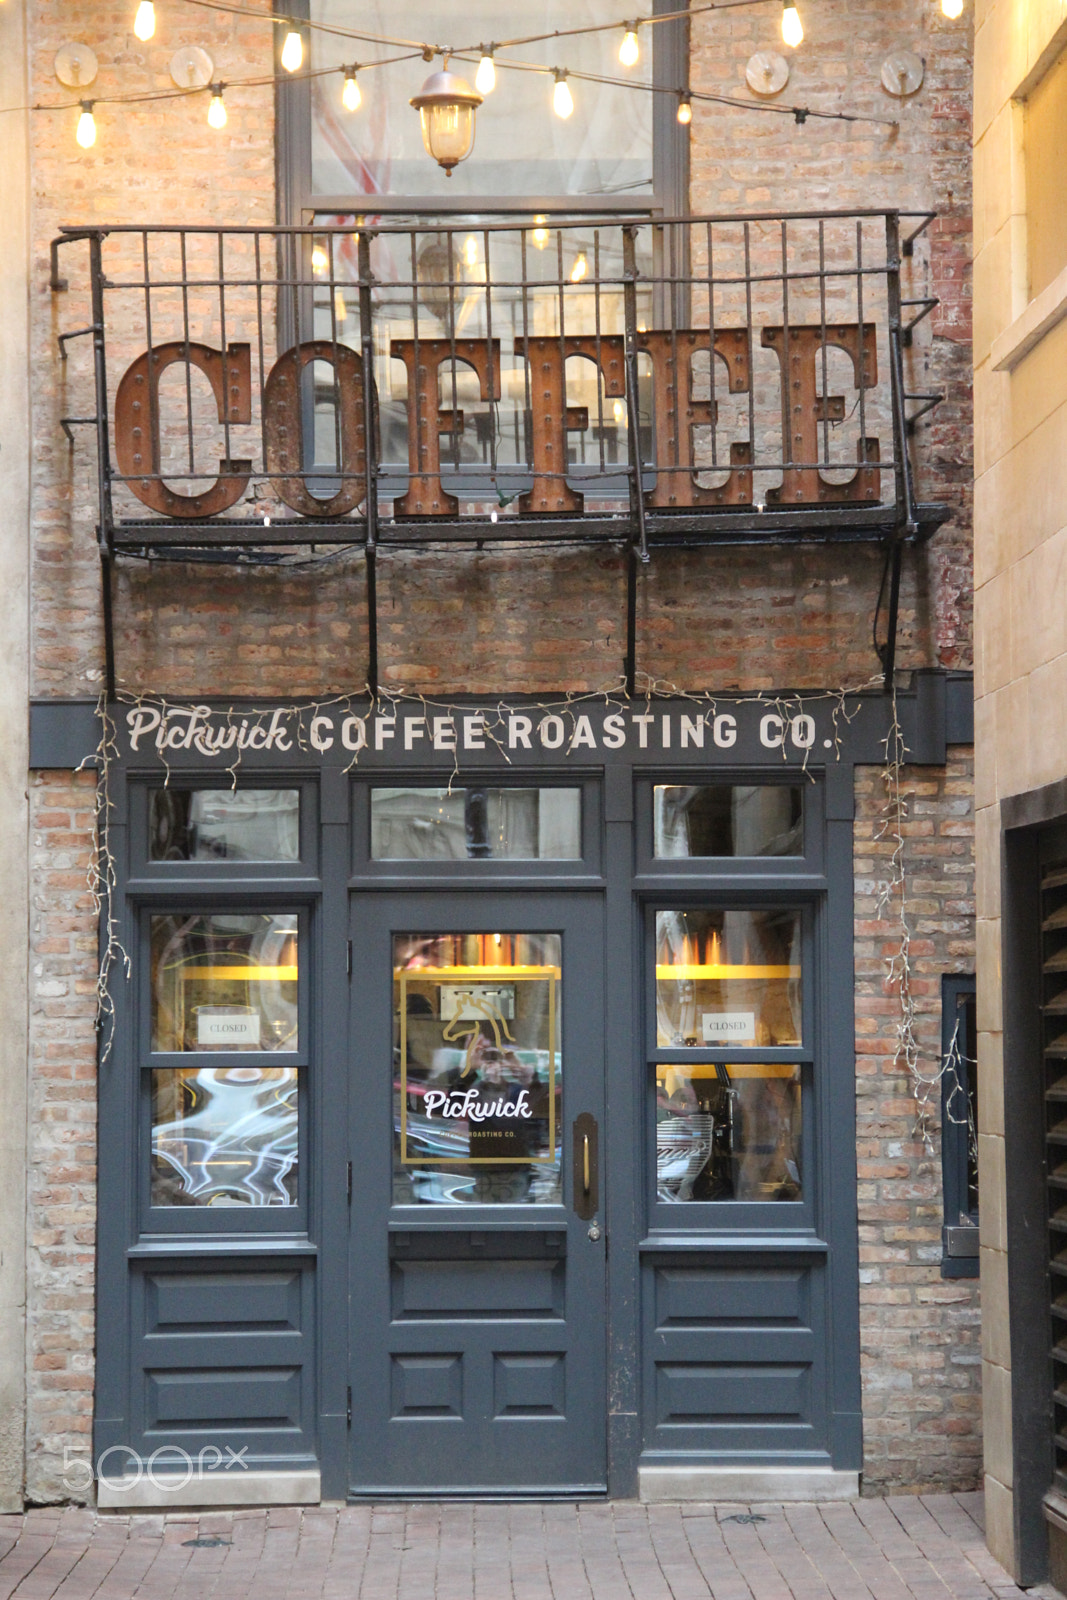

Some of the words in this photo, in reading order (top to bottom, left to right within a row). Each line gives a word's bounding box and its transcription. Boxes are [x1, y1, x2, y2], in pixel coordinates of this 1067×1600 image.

[115, 323, 880, 517] COFFEE
[126, 705, 292, 756] Pickwick
[309, 716, 486, 751] COFFEE
[508, 713, 738, 749] ROASTING
[759, 714, 833, 749] CO.
[209, 1023, 247, 1033] CLOSED
[709, 1021, 746, 1031] CLOSED
[423, 1088, 533, 1122] Pickwick
